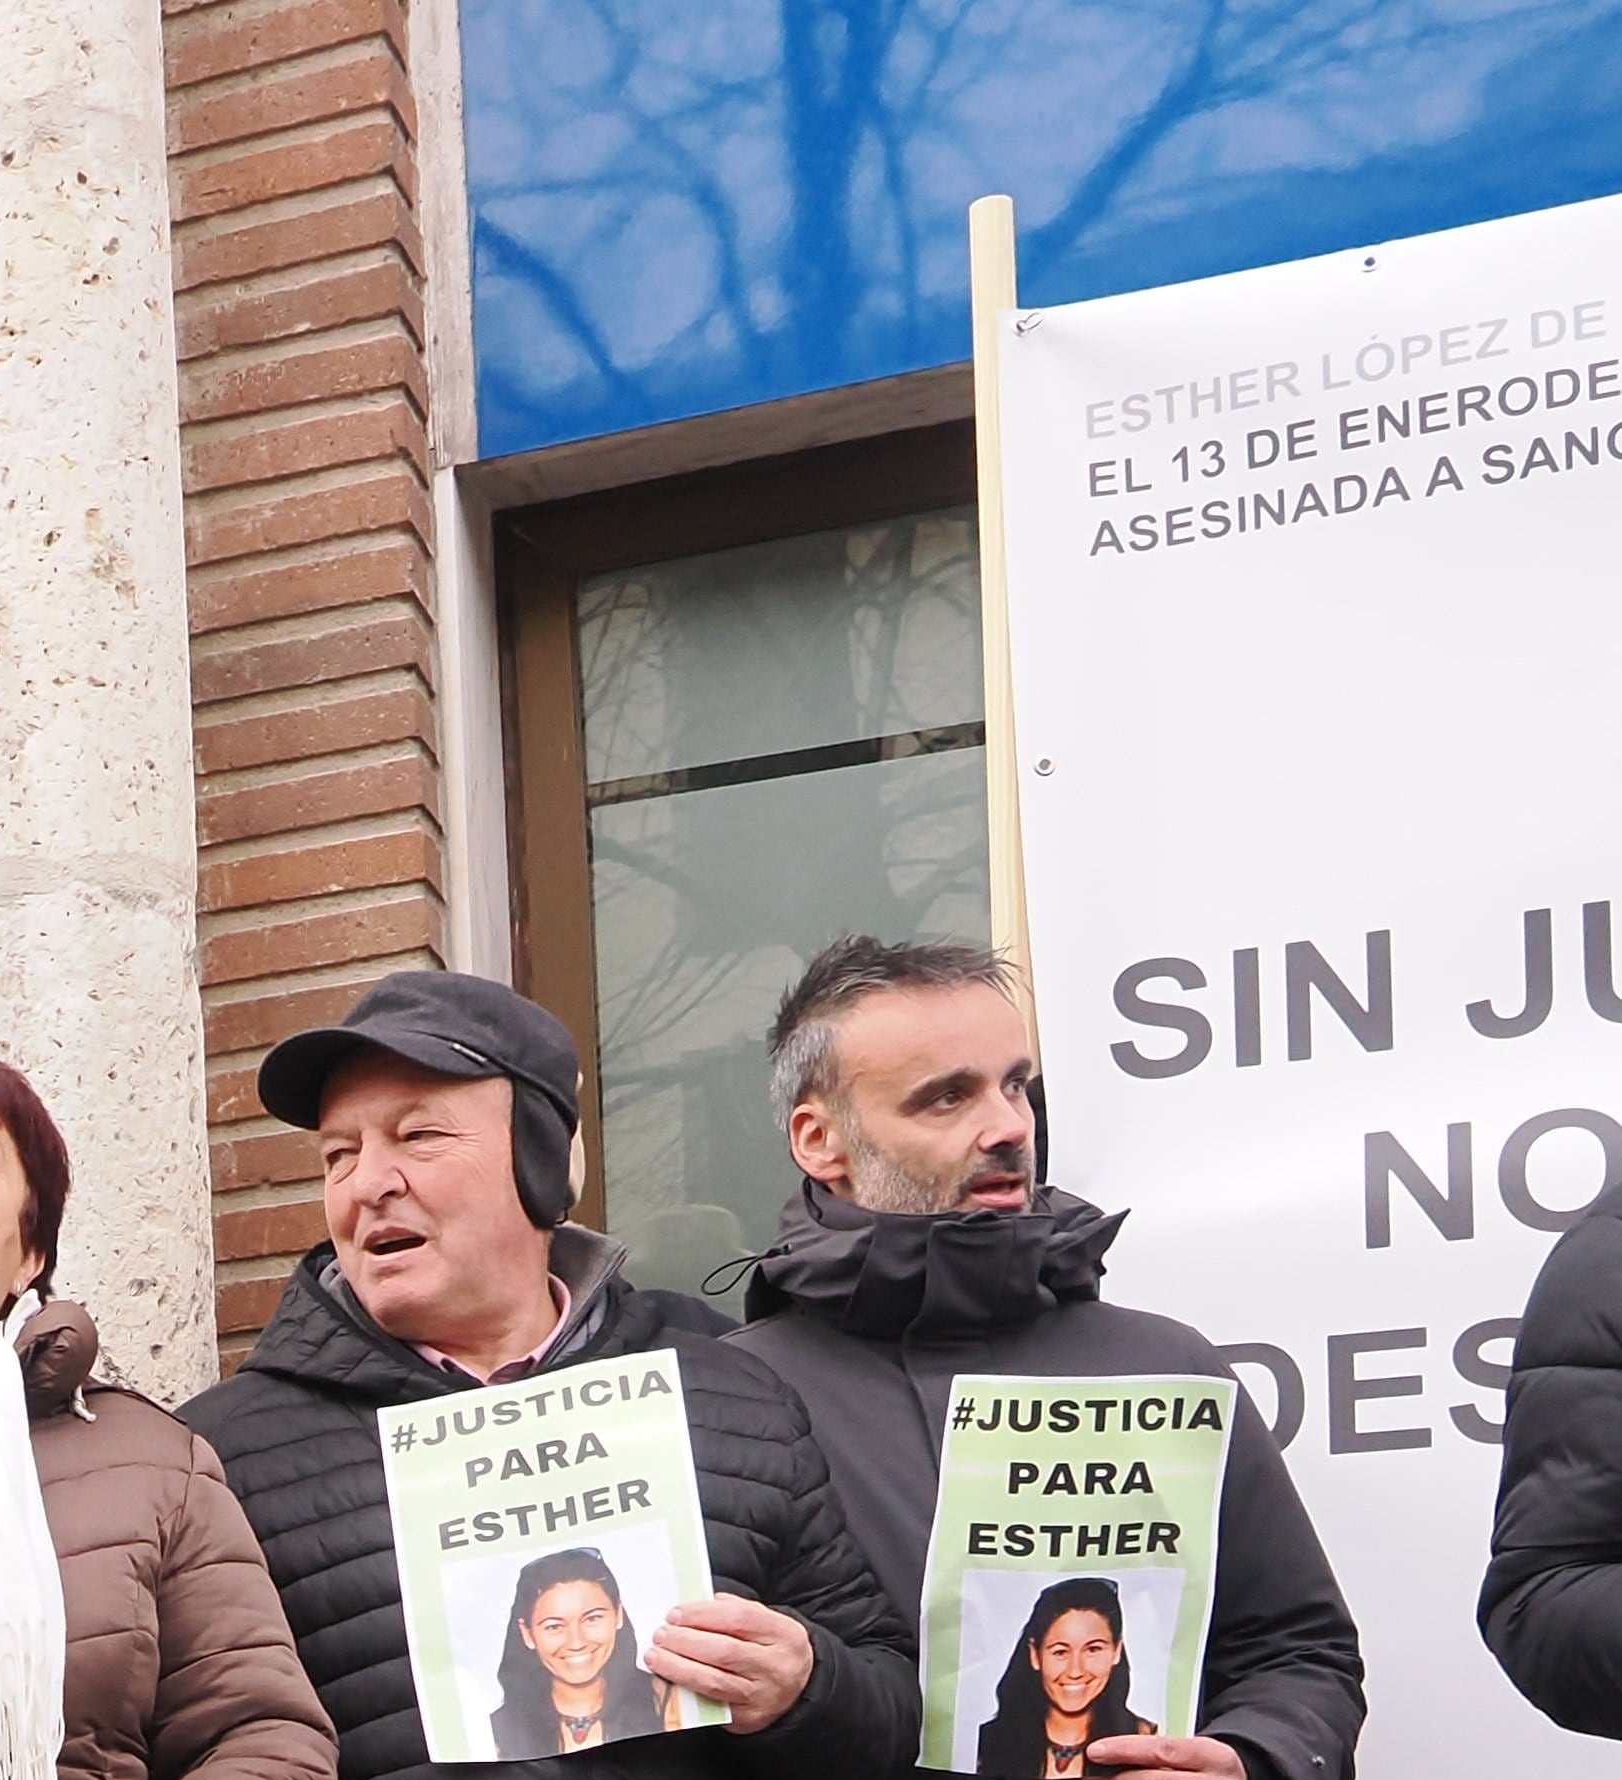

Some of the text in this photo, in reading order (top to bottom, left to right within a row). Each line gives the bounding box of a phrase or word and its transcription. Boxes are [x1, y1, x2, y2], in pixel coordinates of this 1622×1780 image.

[1085, 300, 1607, 439] ESTHER LÓPEZ DE
[1089, 459, 1152, 497] EL
[1172, 439, 1226, 483] 13
[1246, 418, 1318, 469] DE
[1090, 466, 1411, 556] ASESINADA
[1425, 455, 1464, 497] A
[1109, 929, 1395, 1079] SIN
[1363, 1107, 1622, 1249] NO
[389, 1369, 674, 1456] #JUSTICIA
[952, 1397, 1224, 1433] #JUSTICIA
[465, 1431, 609, 1489] PARA
[1007, 1461, 1154, 1496] PARA
[438, 1476, 653, 1552] ESTHER
[967, 1522, 1181, 1558] ESTHER
